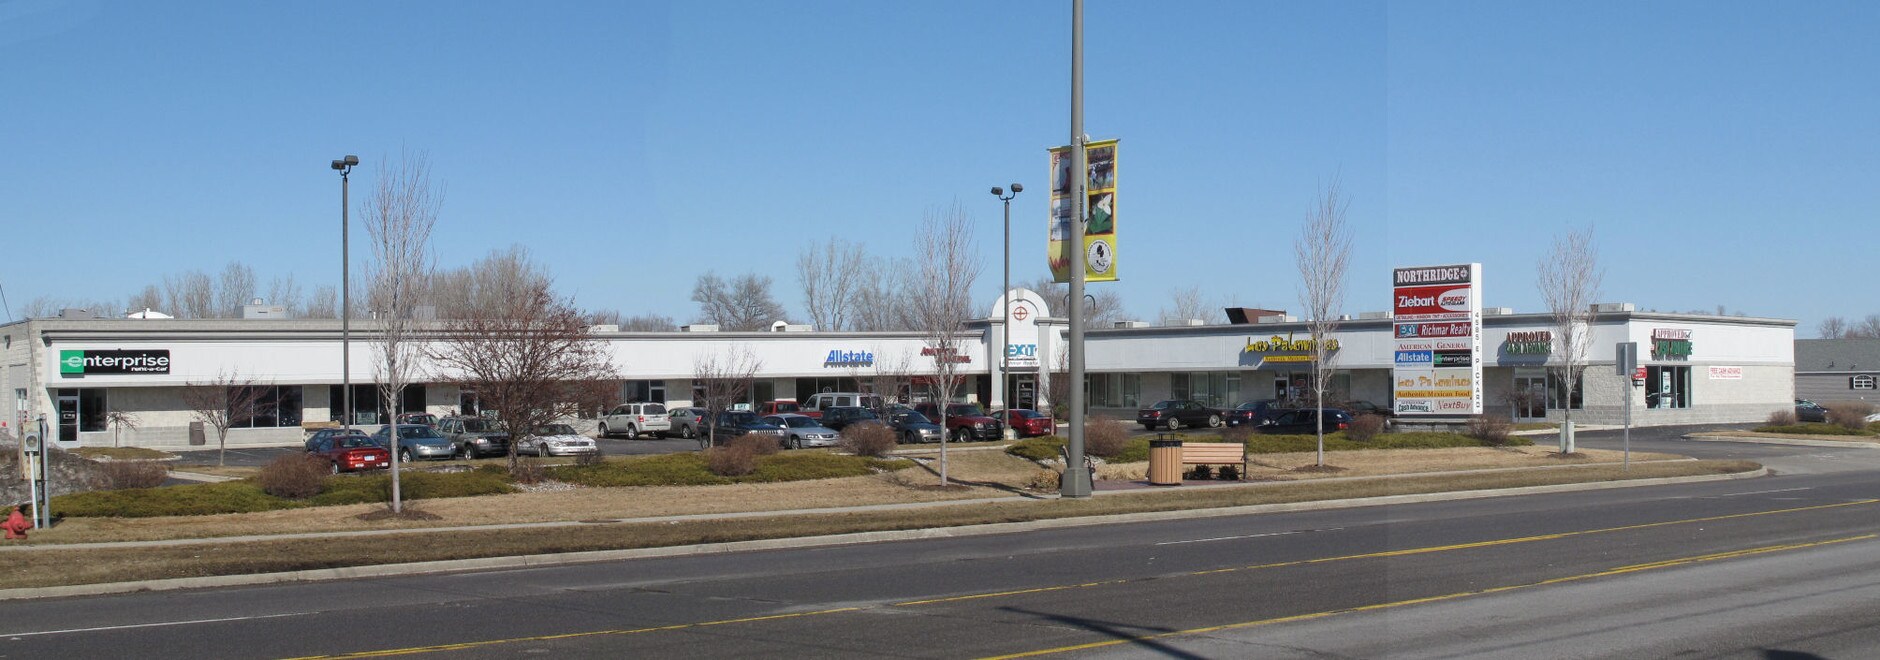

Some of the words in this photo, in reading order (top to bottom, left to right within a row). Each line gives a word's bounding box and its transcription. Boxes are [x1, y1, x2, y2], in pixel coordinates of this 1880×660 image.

[1396, 267, 1460, 283] NORTHRIDGE
[1398, 296, 1435, 308] Ziebart
[1421, 324, 1448, 336] Richmar
[1449, 322, 1472, 337] Realty
[1655, 330, 1686, 339] APPROVED
[1506, 331, 1551, 343] APPROVED
[1398, 343, 1432, 351] AMERICAN
[1436, 341, 1467, 349] GENERAL
[826, 350, 873, 362] Allstate
[1397, 352, 1430, 362] Allstate
[67, 354, 169, 370] enterprise
[1397, 389, 1425, 398] Authentic
[1427, 388, 1453, 397] Mexican
[1454, 388, 1470, 397] Food
[1398, 404, 1410, 412] Cash
[1410, 403, 1429, 412] Advance
[1436, 400, 1471, 411] NextBuy
